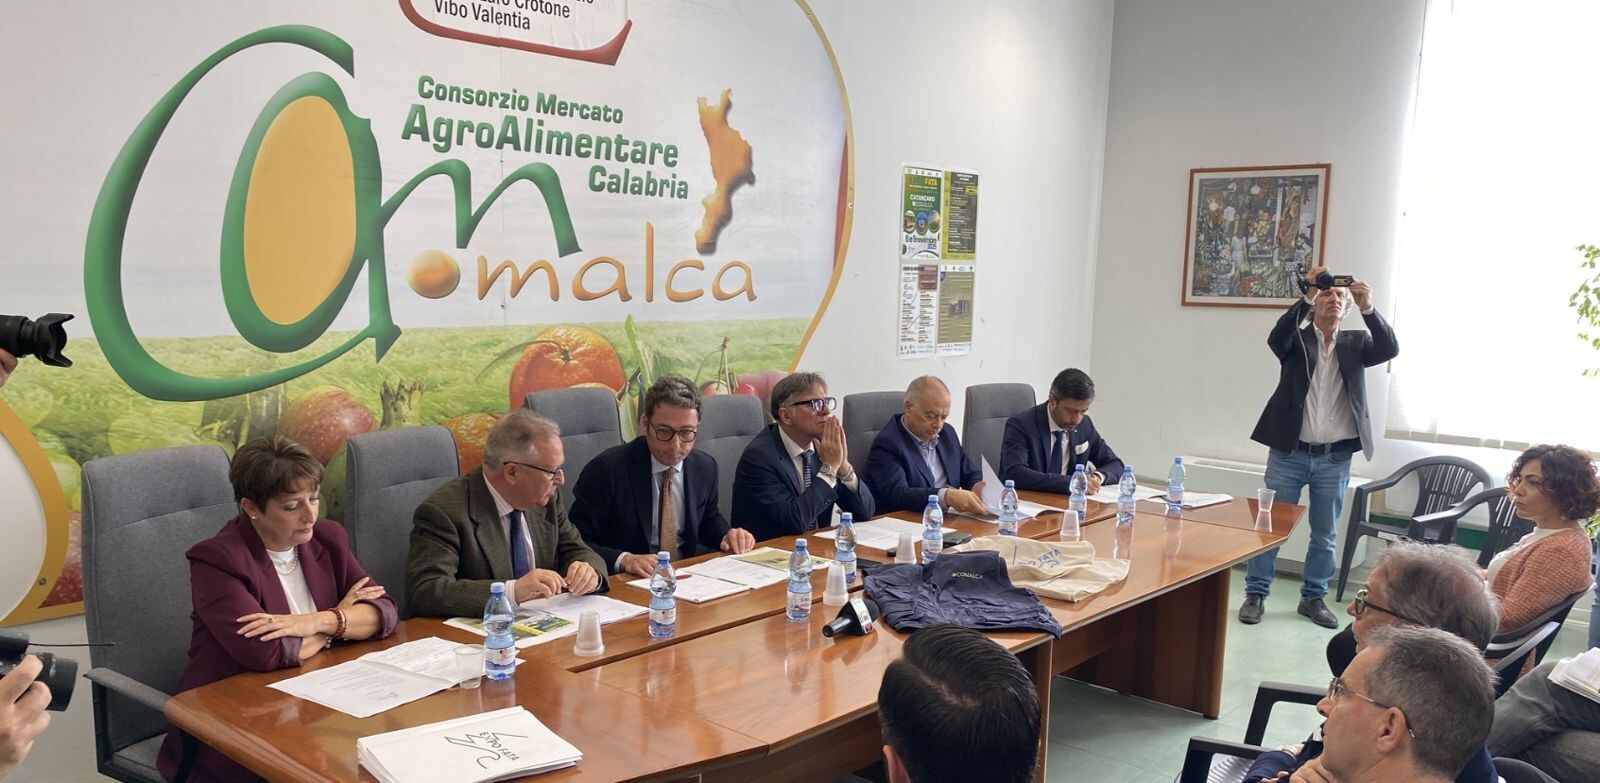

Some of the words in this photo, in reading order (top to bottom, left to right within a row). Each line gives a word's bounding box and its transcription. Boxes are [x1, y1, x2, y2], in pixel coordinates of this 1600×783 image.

[434, 0, 468, 18] Vibo
[472, 2, 531, 30] Valentia
[417, 74, 530, 112] Consorzio
[535, 92, 624, 124] Mercato
[400, 103, 679, 168] AgroAlimentare
[588, 165, 689, 200] Calabria
[1038, 548, 1062, 562] FATA
[479, 731, 502, 748] EXPO
